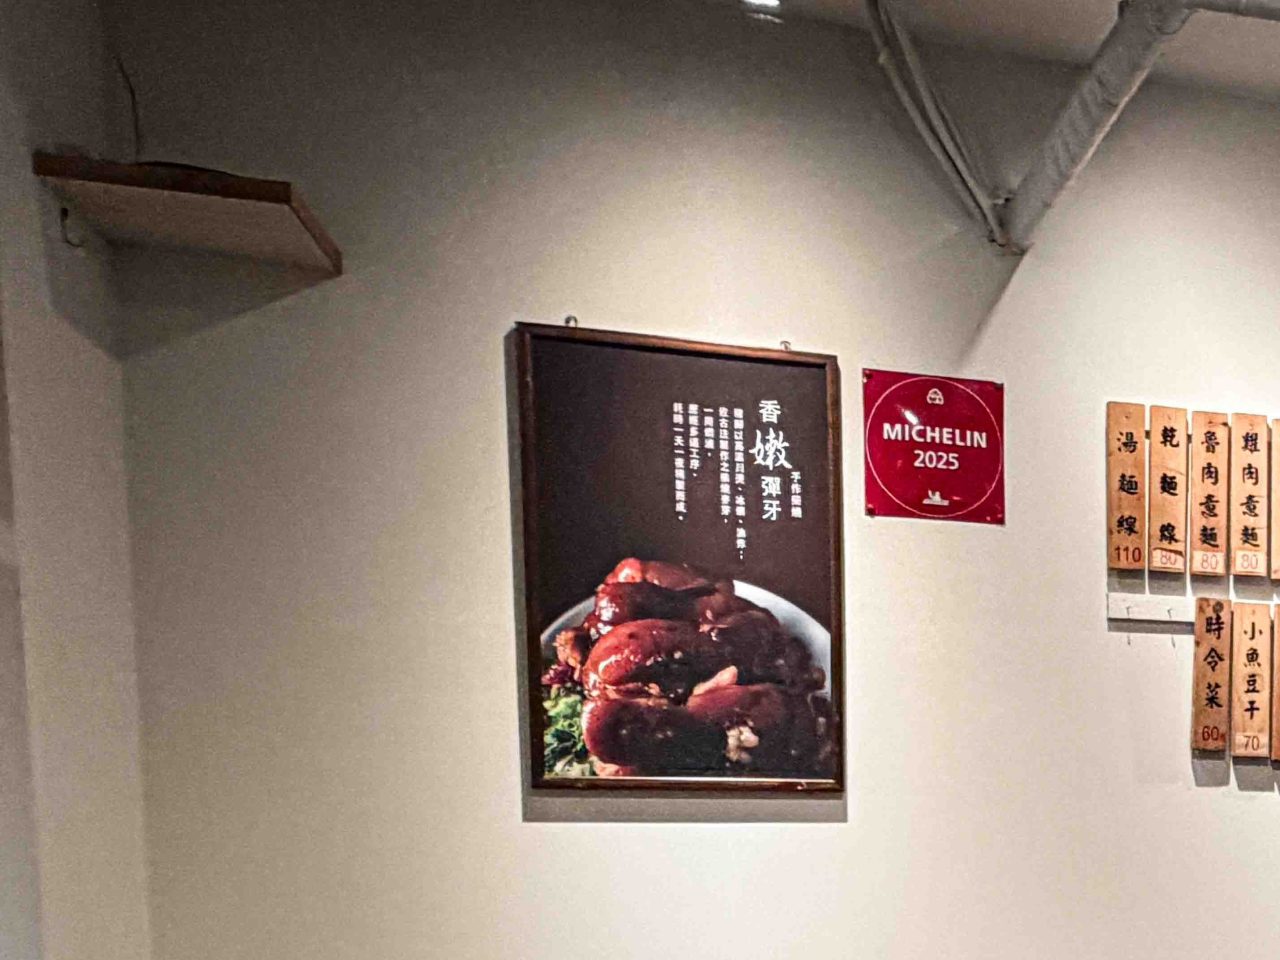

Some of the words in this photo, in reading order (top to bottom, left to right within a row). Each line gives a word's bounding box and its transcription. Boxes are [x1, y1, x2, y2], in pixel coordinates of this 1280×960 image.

[883, 422, 987, 448] MICHELIN
[913, 450, 959, 470] 2025
[1114, 546, 1142, 563] 110
[1201, 554, 1218, 570] 80
[1240, 553, 1258, 570] 80
[1203, 614, 1225, 709] 時令菜
[1244, 622, 1263, 720] 小魚豆干
[1244, 736, 1260, 751] 70
